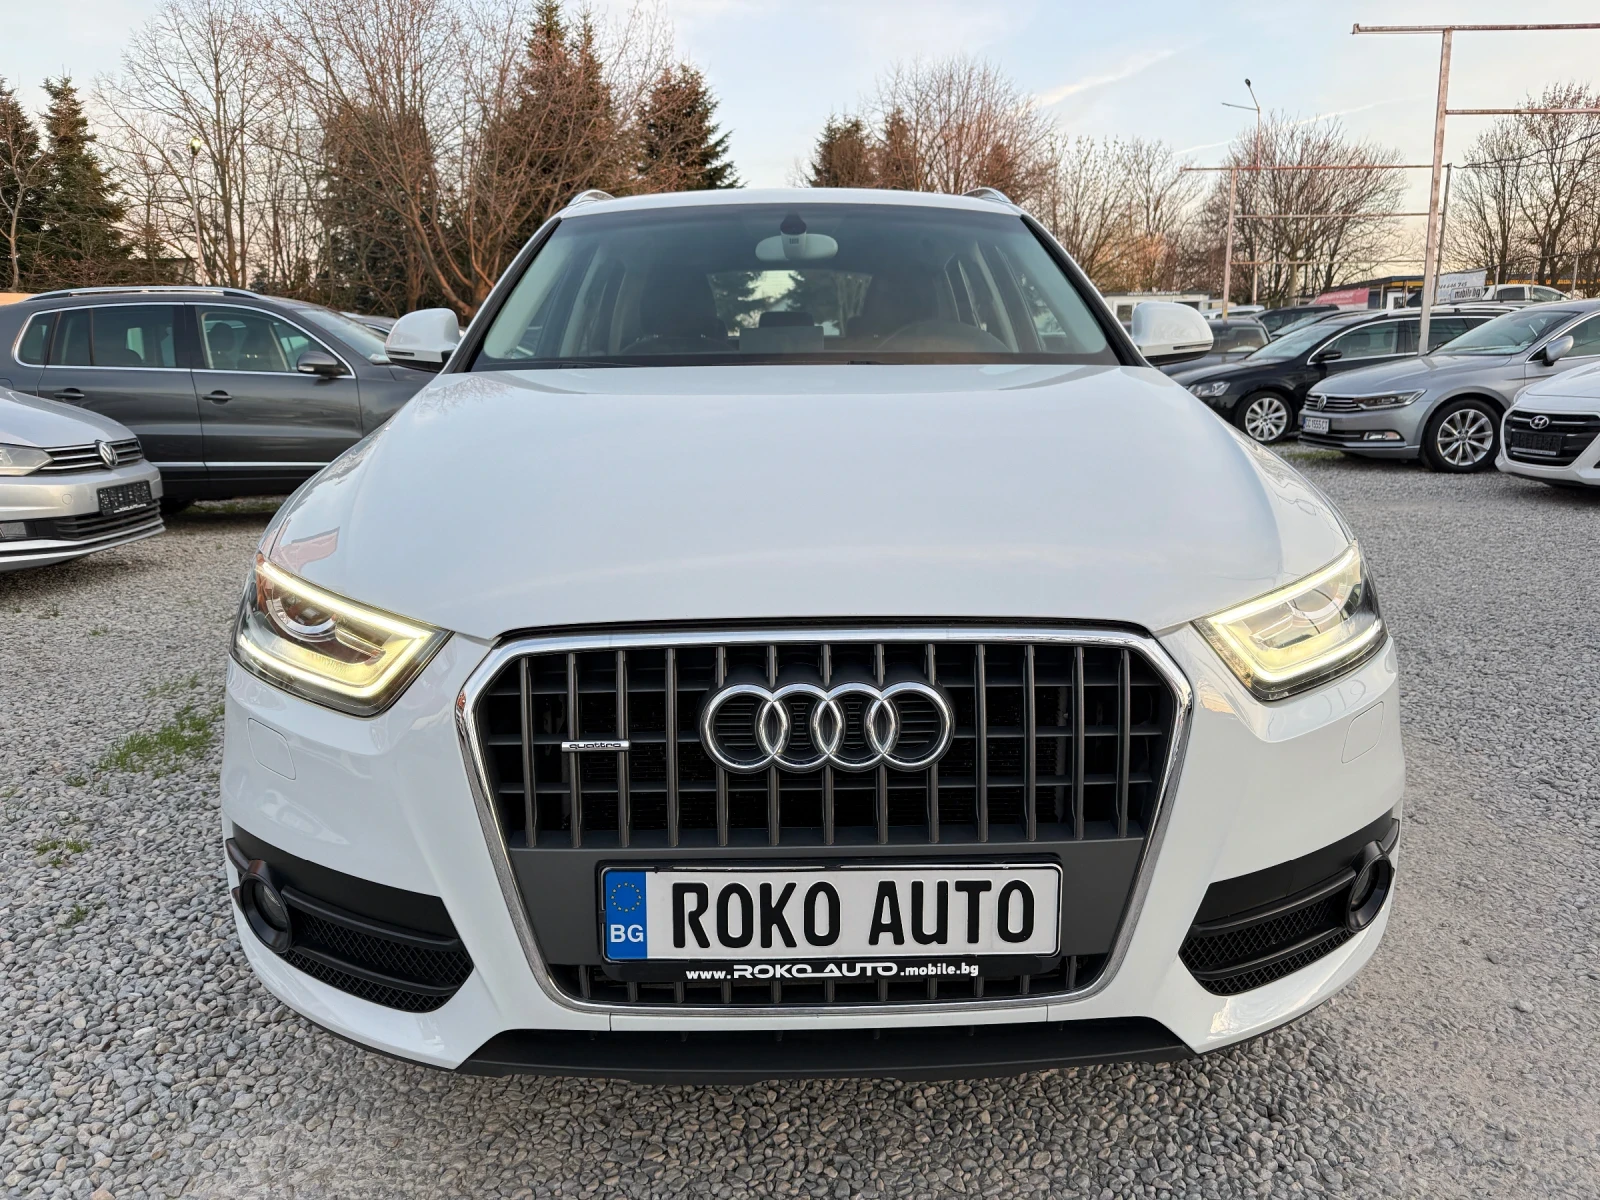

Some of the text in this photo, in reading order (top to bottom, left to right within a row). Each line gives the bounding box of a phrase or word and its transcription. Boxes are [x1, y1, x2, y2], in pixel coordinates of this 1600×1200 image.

[568, 741, 622, 751] quattro
[672, 879, 1035, 949] ROKO AUTO
[610, 924, 644, 943] BG
